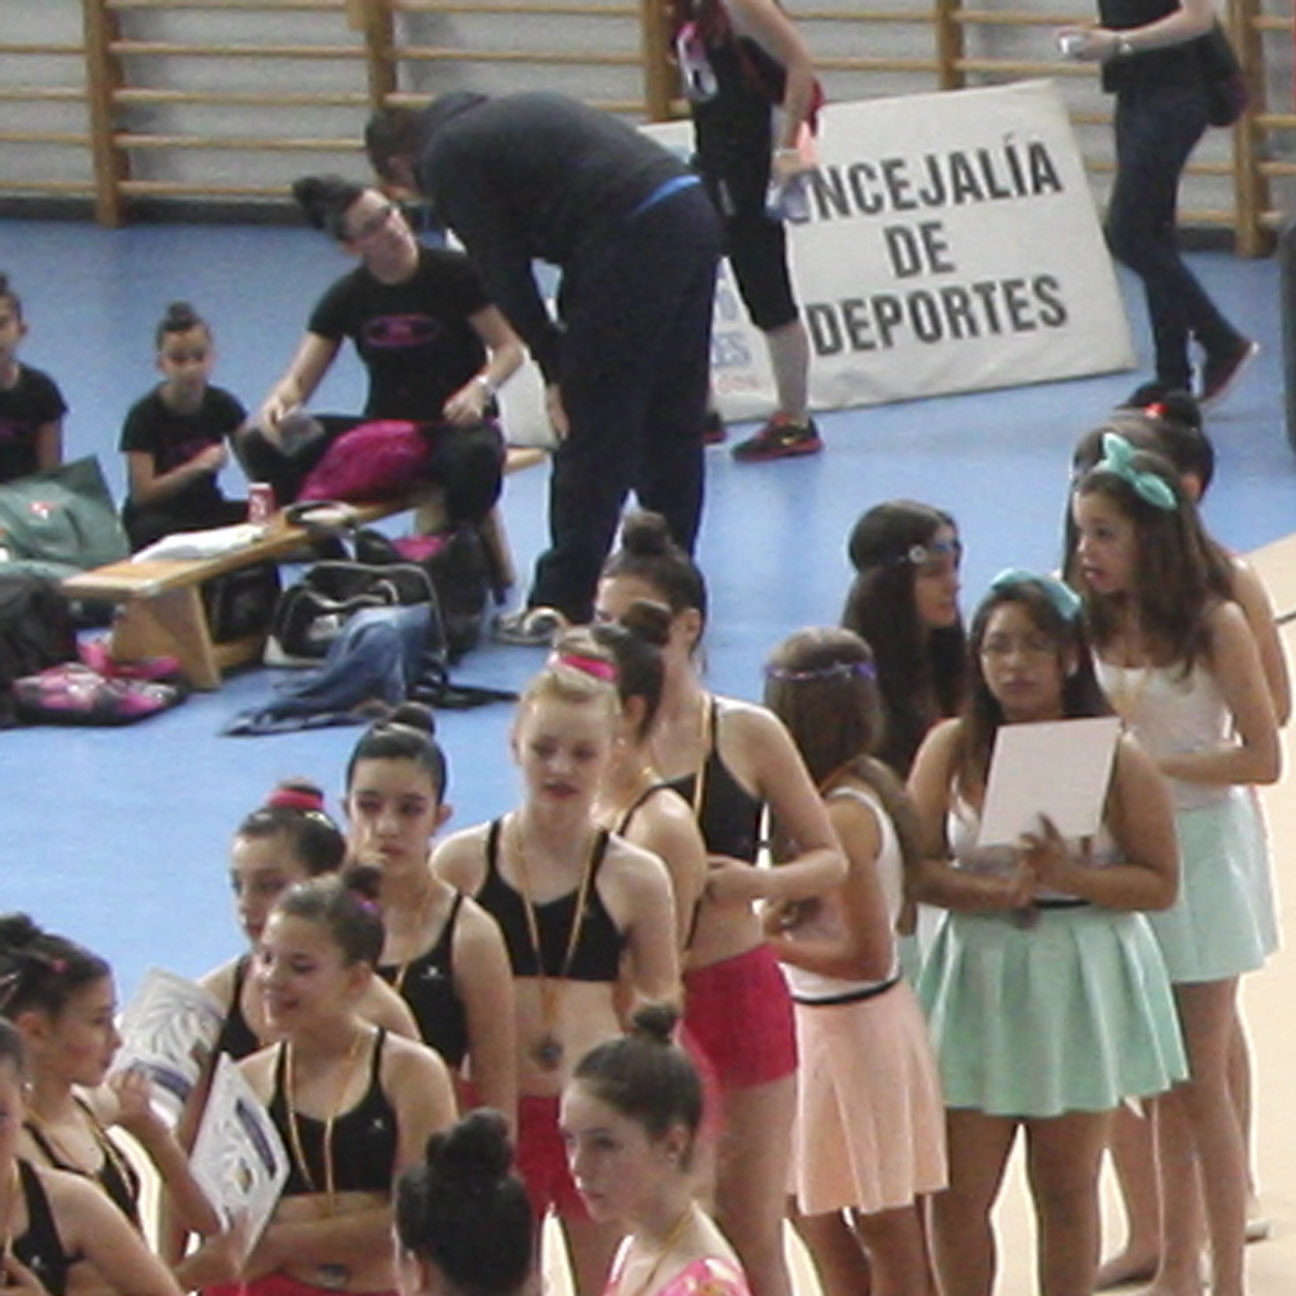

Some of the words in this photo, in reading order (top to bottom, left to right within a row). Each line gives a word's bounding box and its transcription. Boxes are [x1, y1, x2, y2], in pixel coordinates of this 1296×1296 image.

[800, 132, 1063, 222] NCEJALÍA
[883, 221, 955, 278] DE
[806, 274, 1068, 356] DEPORTES
